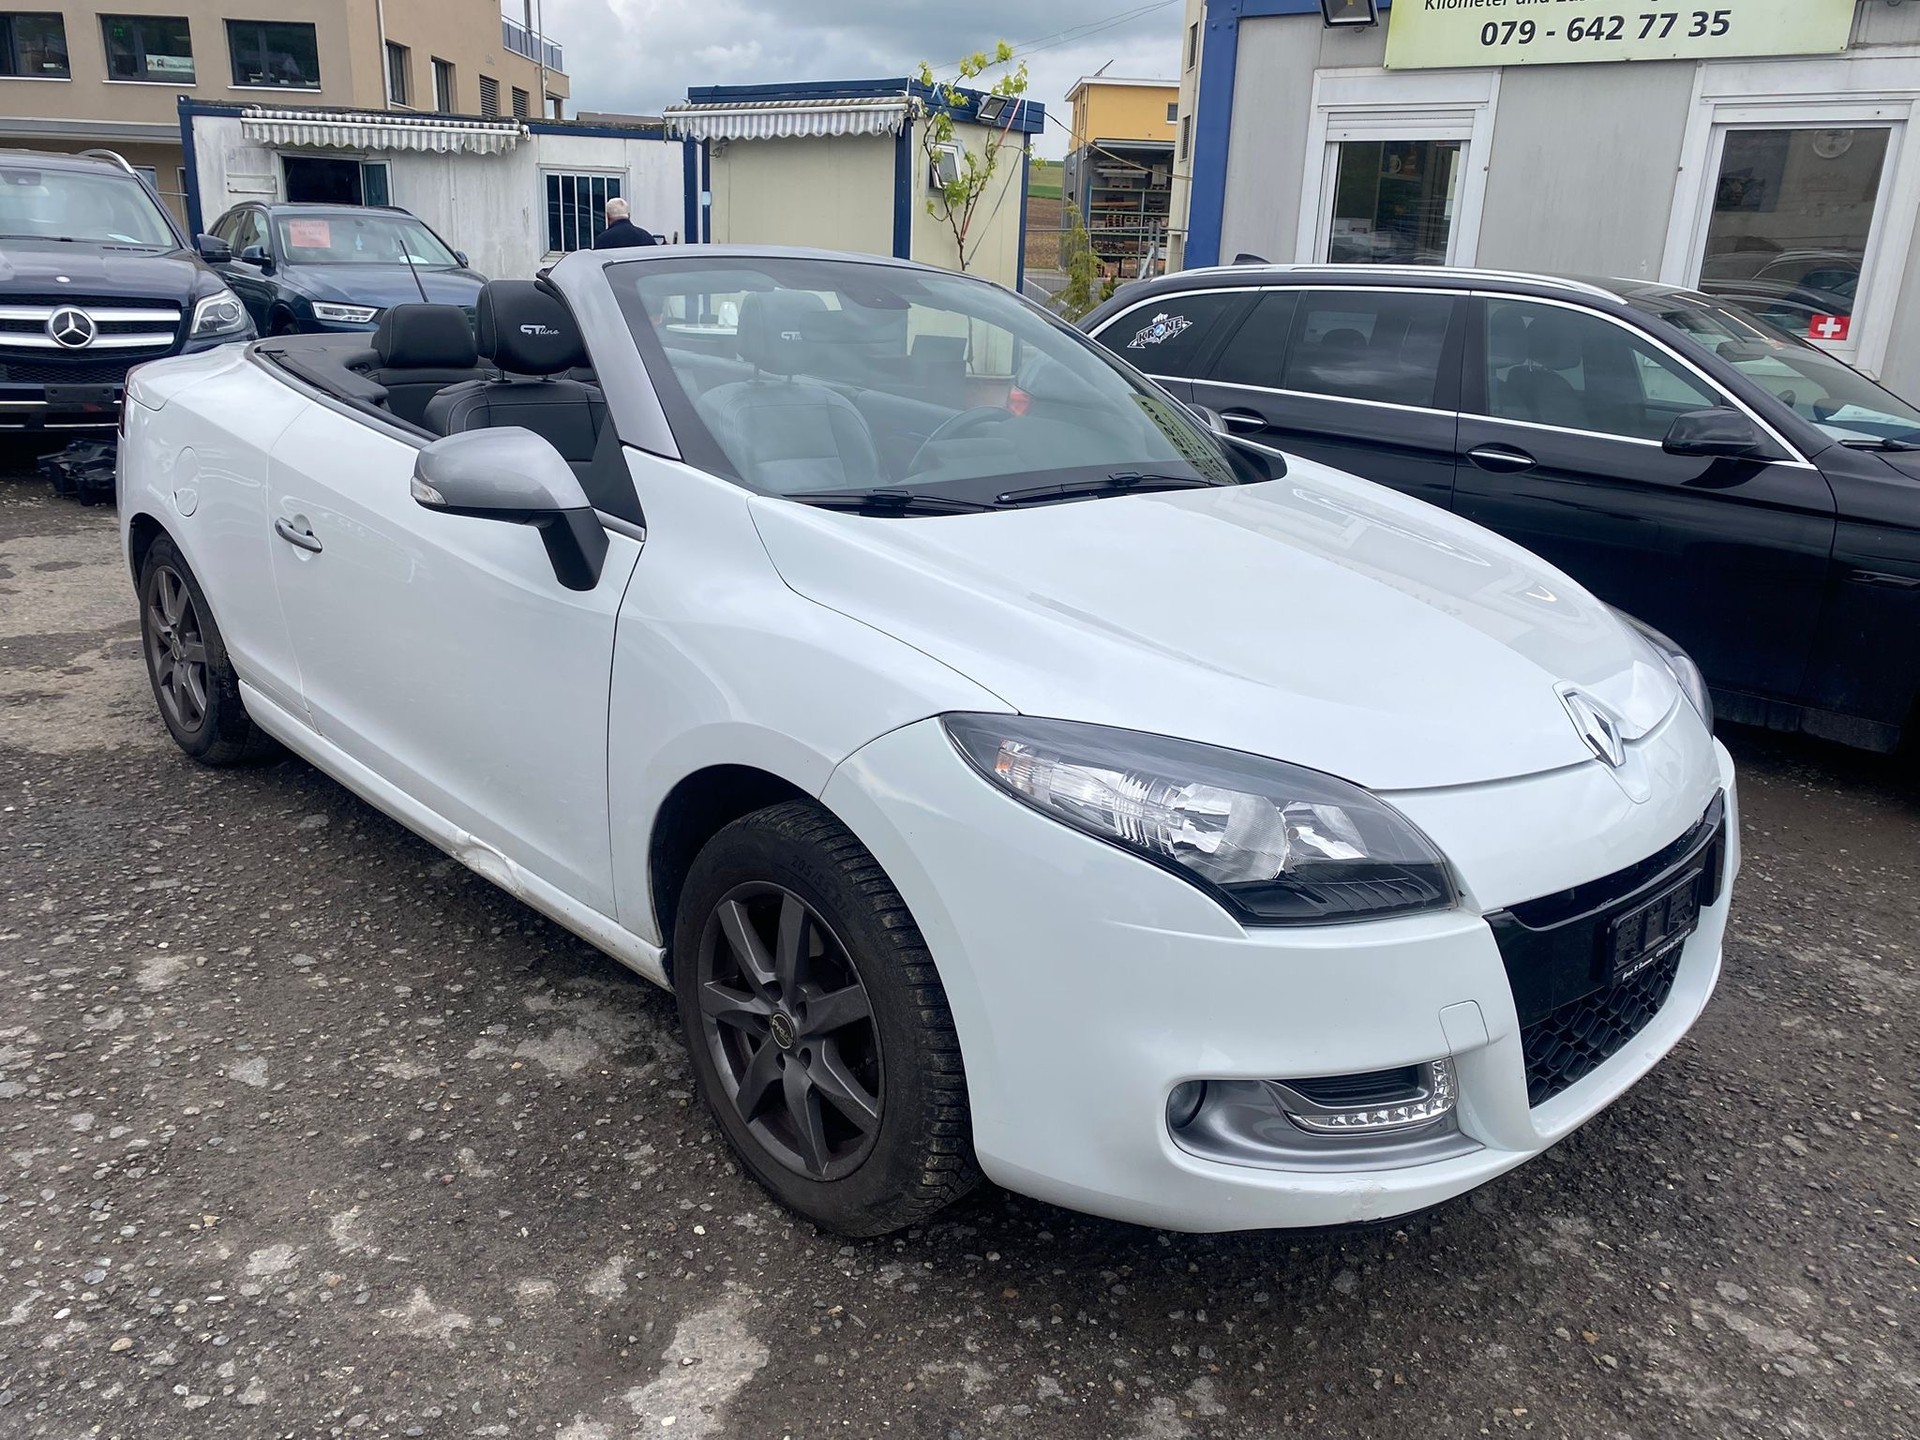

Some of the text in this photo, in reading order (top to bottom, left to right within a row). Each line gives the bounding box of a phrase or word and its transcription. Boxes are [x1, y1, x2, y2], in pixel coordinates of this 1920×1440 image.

[1480, 19, 1536, 46] 079
[1566, 15, 1625, 42] 642
[1637, 12, 1679, 40] 77
[1688, 9, 1732, 37] 35
